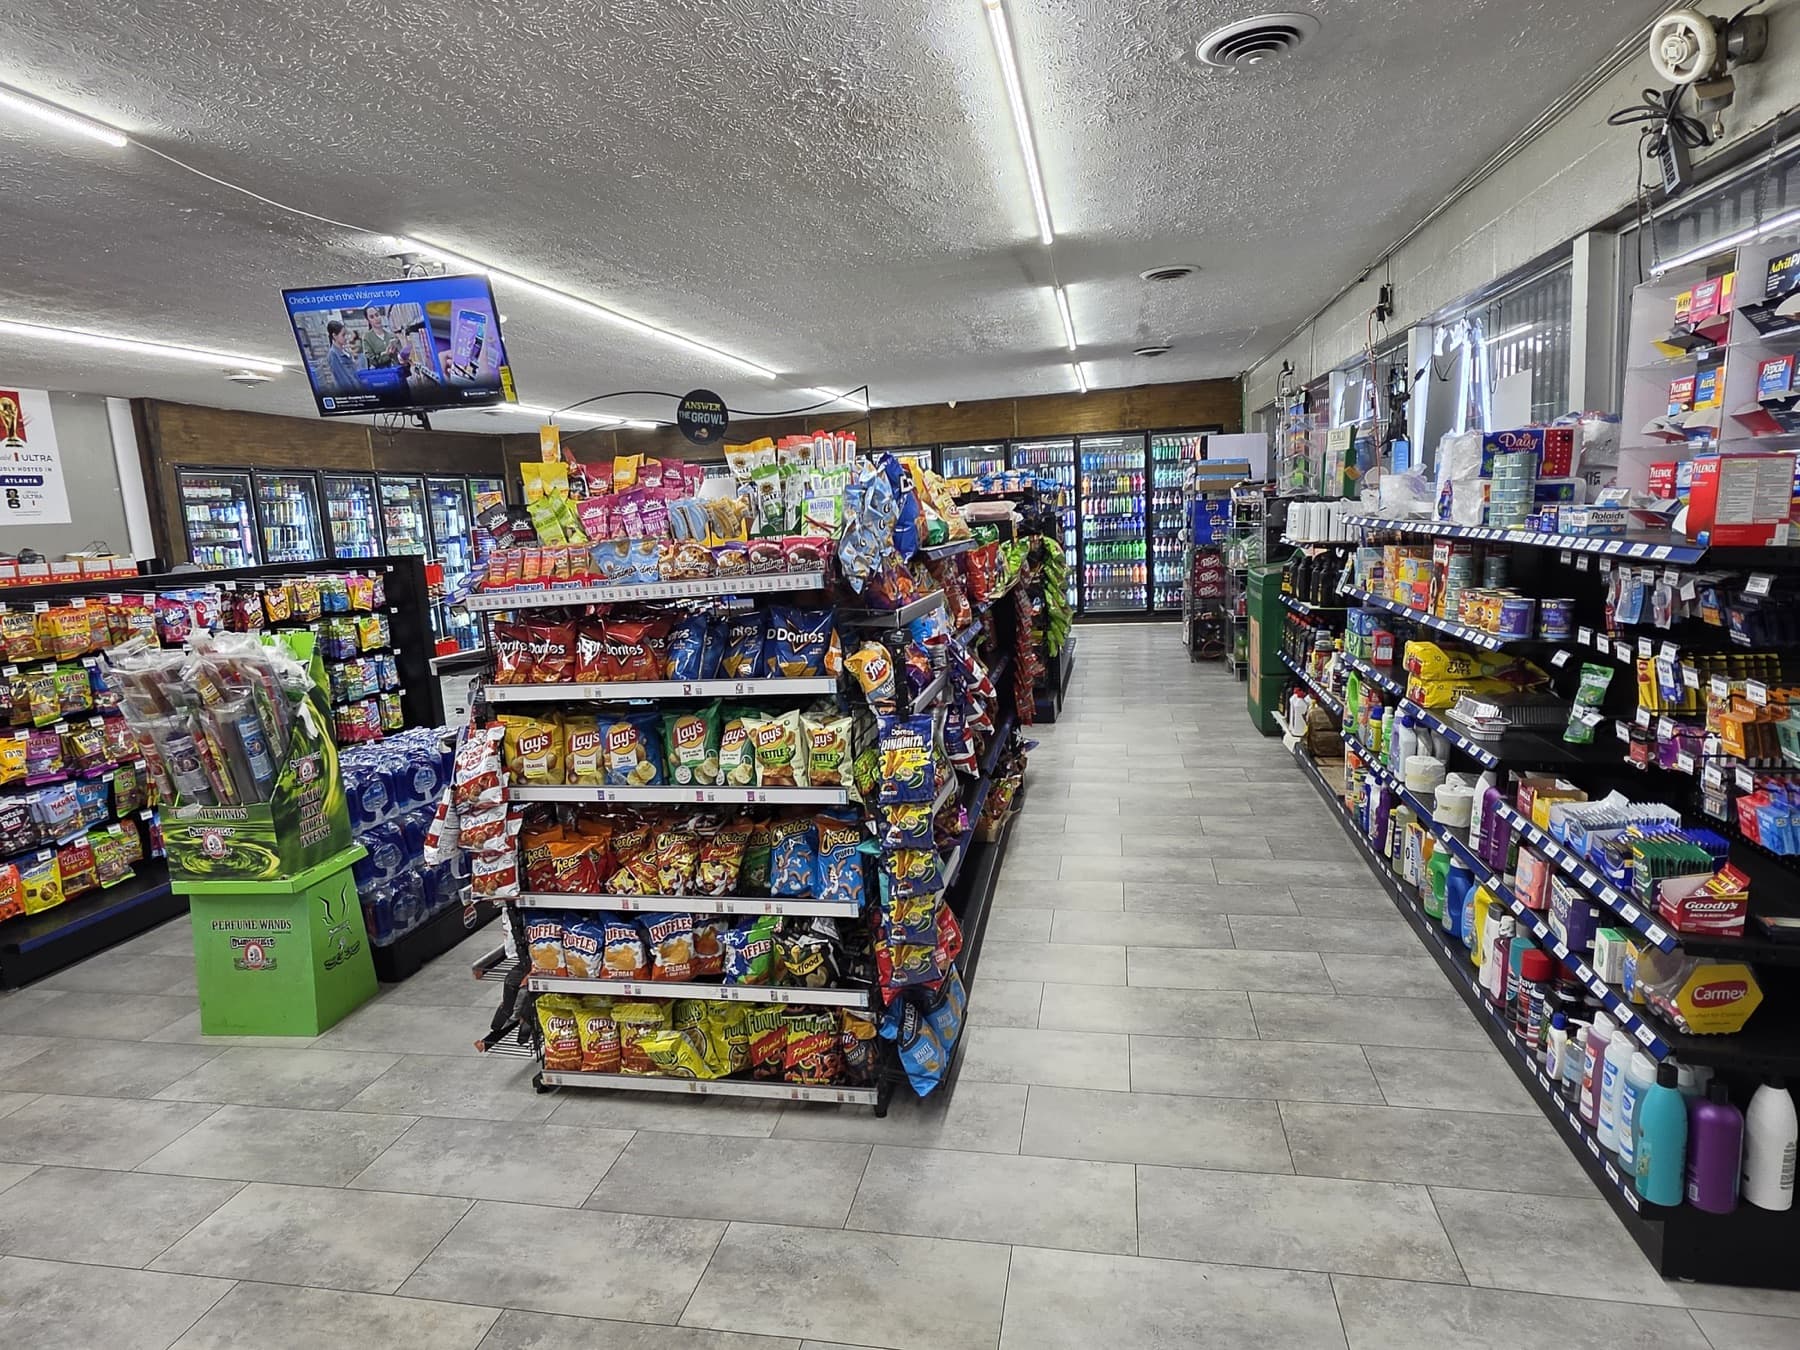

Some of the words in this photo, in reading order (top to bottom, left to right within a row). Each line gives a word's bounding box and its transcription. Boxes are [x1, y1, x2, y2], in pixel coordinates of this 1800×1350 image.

[1771, 256, 1792, 273] Advil
[289, 296, 311, 305] Check
[317, 295, 335, 304] price
[355, 290, 385, 300] Walmart
[385, 289, 401, 298] app
[684, 401, 721, 411] ANSWER
[679, 410, 690, 419] THE
[691, 412, 725, 425] GROWL
[1499, 432, 1540, 449] Daisy
[21, 454, 54, 462] ULTRA
[1650, 467, 1672, 478] TYLENOL
[1692, 463, 1717, 473] TYLENOL
[1591, 512, 1625, 520] Rolaids
[777, 628, 825, 643] Doritos
[606, 643, 644, 656] Doritos
[1450, 661, 1471, 669] TIDY
[609, 728, 636, 748] Lay's
[677, 721, 704, 744] Lay's
[759, 726, 782, 745] Lay's
[519, 734, 549, 755] Lay's
[571, 731, 600, 751] Lay's
[881, 735, 923, 751] DINAMITA
[822, 835, 860, 861] Cheetos
[1685, 901, 1739, 910] Goody's
[212, 919, 258, 931] PERFUME
[259, 919, 292, 930] WANDS
[650, 918, 692, 944] RUFFLES
[563, 932, 597, 953] RUFFLES
[1694, 986, 1746, 1001] Carmex
